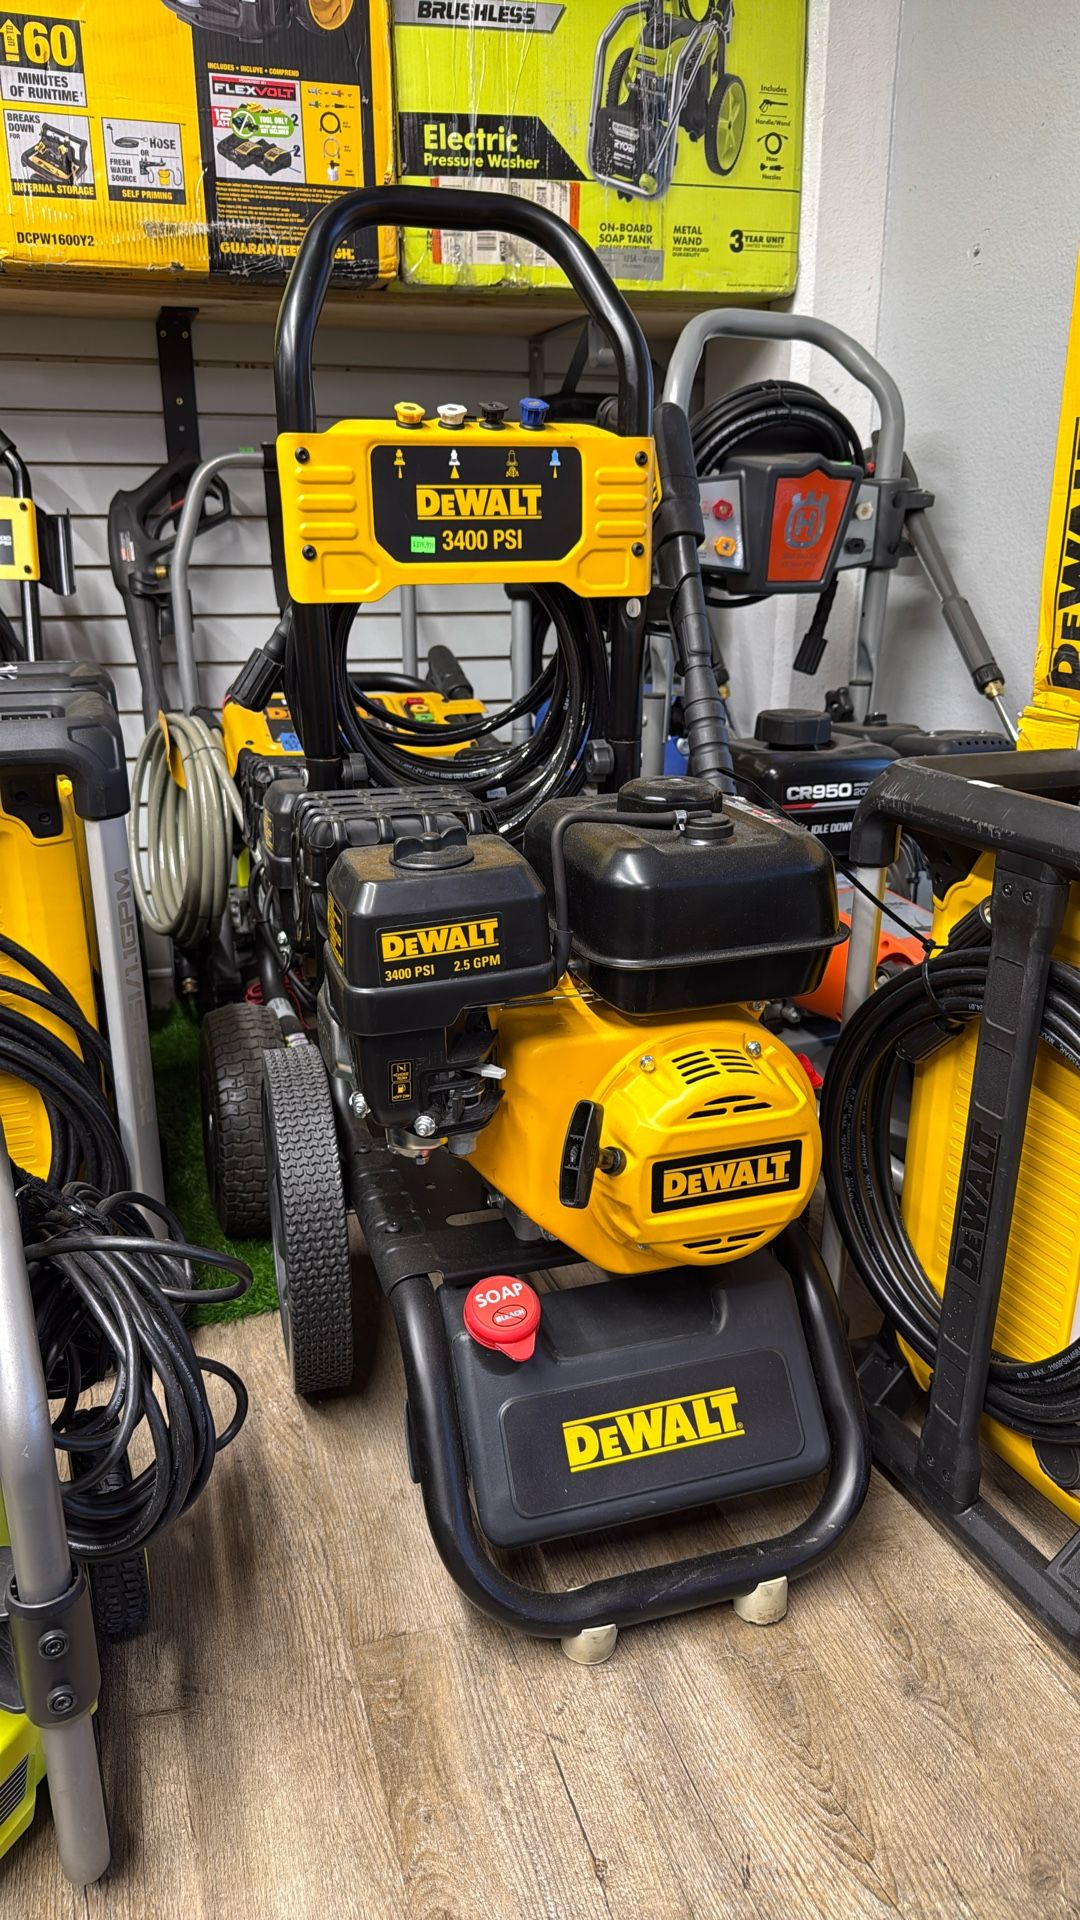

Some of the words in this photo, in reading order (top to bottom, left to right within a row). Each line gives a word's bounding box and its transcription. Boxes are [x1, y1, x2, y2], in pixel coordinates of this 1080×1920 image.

[417, 1, 535, 25] BRUSHLESS
[6, 24, 14, 35] TO
[7, 36, 15, 47] UP
[23, 21, 77, 67] 60
[207, 62, 235, 71] INCLUDES
[240, 65, 263, 74] INCLUYE
[269, 68, 299, 77] COMPREND
[17, 72, 69, 88] MINUTES
[10, 85, 24, 97] OF
[214, 83, 294, 99] FLEXVOLT
[761, 84, 787, 93] Includes
[7, 113, 41, 124] BREAKS
[214, 108, 231, 120] 12
[291, 114, 298, 126] 2
[259, 116, 272, 124] TOOL
[274, 117, 288, 125] ONLY
[8, 123, 34, 133] DOWN
[424, 123, 518, 152] Electric
[150, 138, 177, 150] HOSE
[613, 139, 635, 154] RYOBI
[140, 149, 149, 157] OR
[293, 145, 301, 157] 2
[110, 158, 131, 166] FRESH
[424, 152, 484, 168] Pressure
[487, 154, 540, 170] Washer
[111, 167, 133, 175] WATER
[111, 175, 137, 183] SOURCE
[13, 182, 55, 194] INTERNAL
[57, 184, 95, 196] STORAGE
[121, 189, 139, 198] SELF
[141, 190, 173, 200] PRIMING
[599, 222, 653, 233] ON-BOARD
[673, 225, 702, 235] METAL
[17, 231, 95, 247] DCPW1600Y2
[599, 233, 625, 243] SOAP
[627, 234, 653, 244] TANK
[673, 236, 702, 246] WAND
[729, 229, 744, 253] 3
[744, 235, 764, 243] YEAR
[766, 236, 785, 244] UNIT
[220, 242, 301, 257] GUARANTEE
[442, 529, 488, 551] 3400
[493, 529, 522, 550] PSI
[786, 783, 852, 800] CR950
[811, 823, 829, 834] IDLE
[384, 968, 412, 982] 3400
[415, 964, 435, 978] PSI
[453, 959, 471, 972] 2.5
[473, 954, 501, 970] GPM
[475, 1283, 523, 1308] SOAP
[495, 1309, 526, 1323] BLEACH
